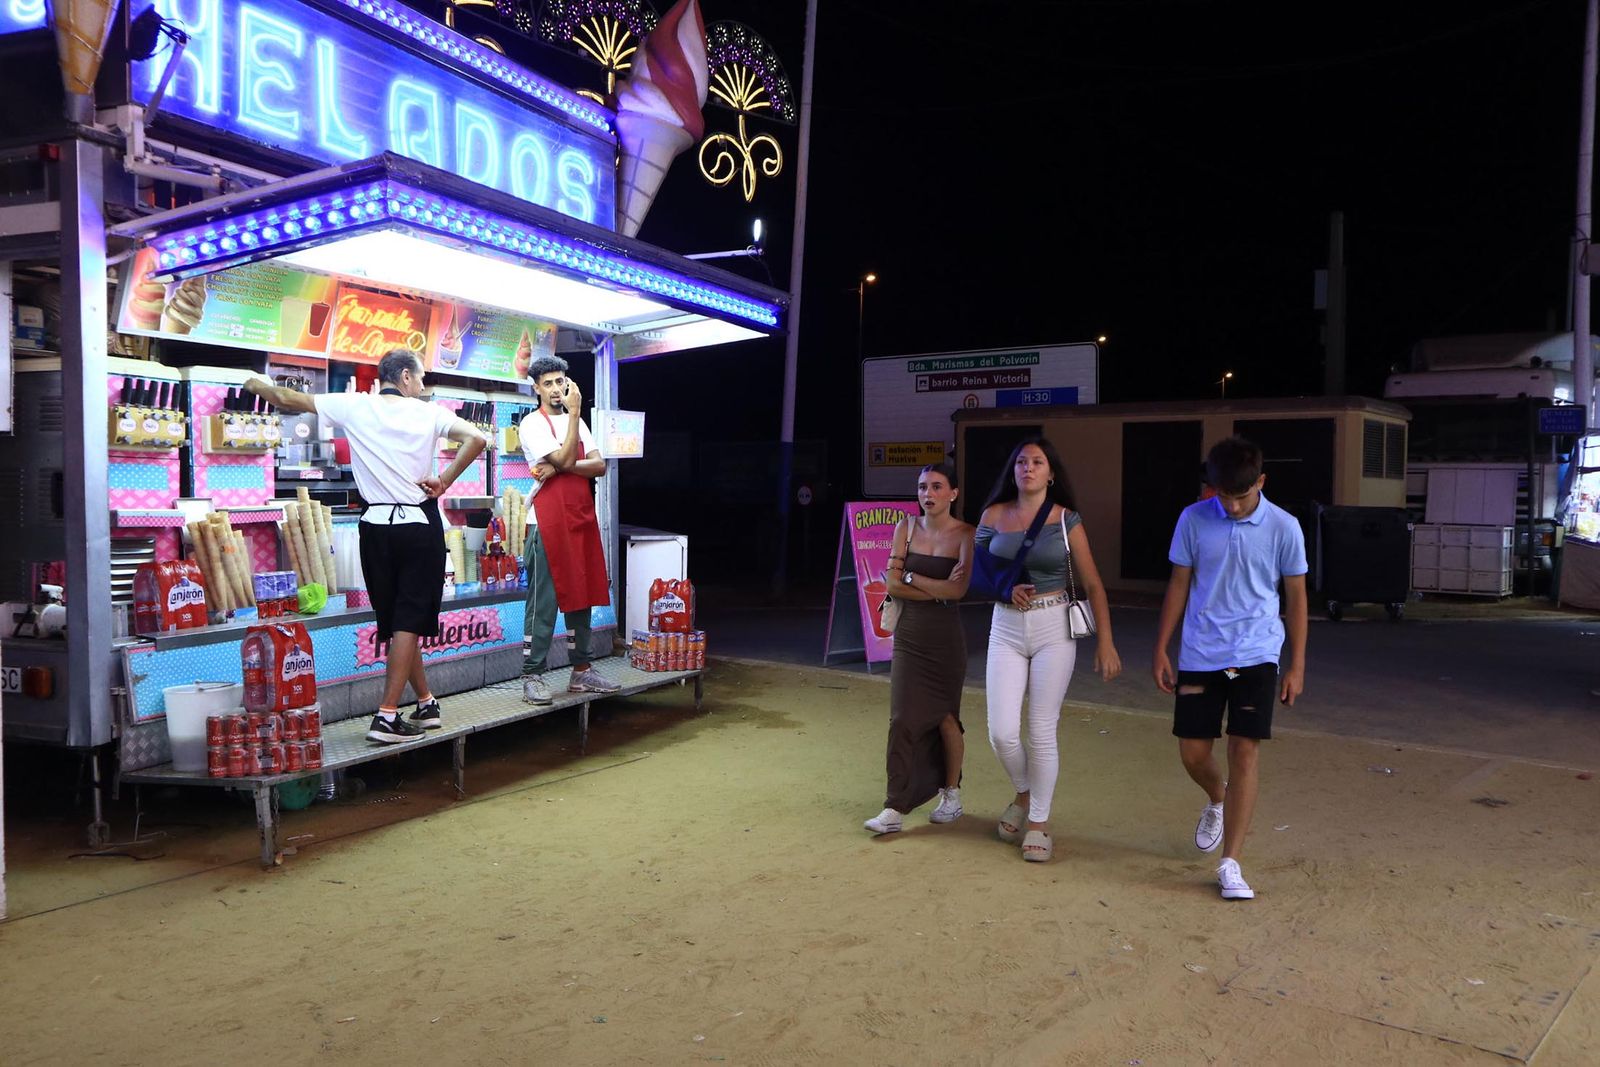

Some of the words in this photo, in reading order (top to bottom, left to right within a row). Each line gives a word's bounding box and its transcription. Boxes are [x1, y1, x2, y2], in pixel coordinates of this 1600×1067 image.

[150, 0, 596, 224] HELADOS
[932, 360, 975, 370] Marismas
[980, 357, 994, 367] del
[932, 376, 958, 387] barrio
[962, 375, 988, 386] Reina
[993, 373, 1029, 384] Victoria
[1024, 392, 1050, 402] H-30
[856, 508, 912, 530] GRANIZAD
[170, 588, 203, 605] anjarón
[658, 601, 684, 609] anjarón
